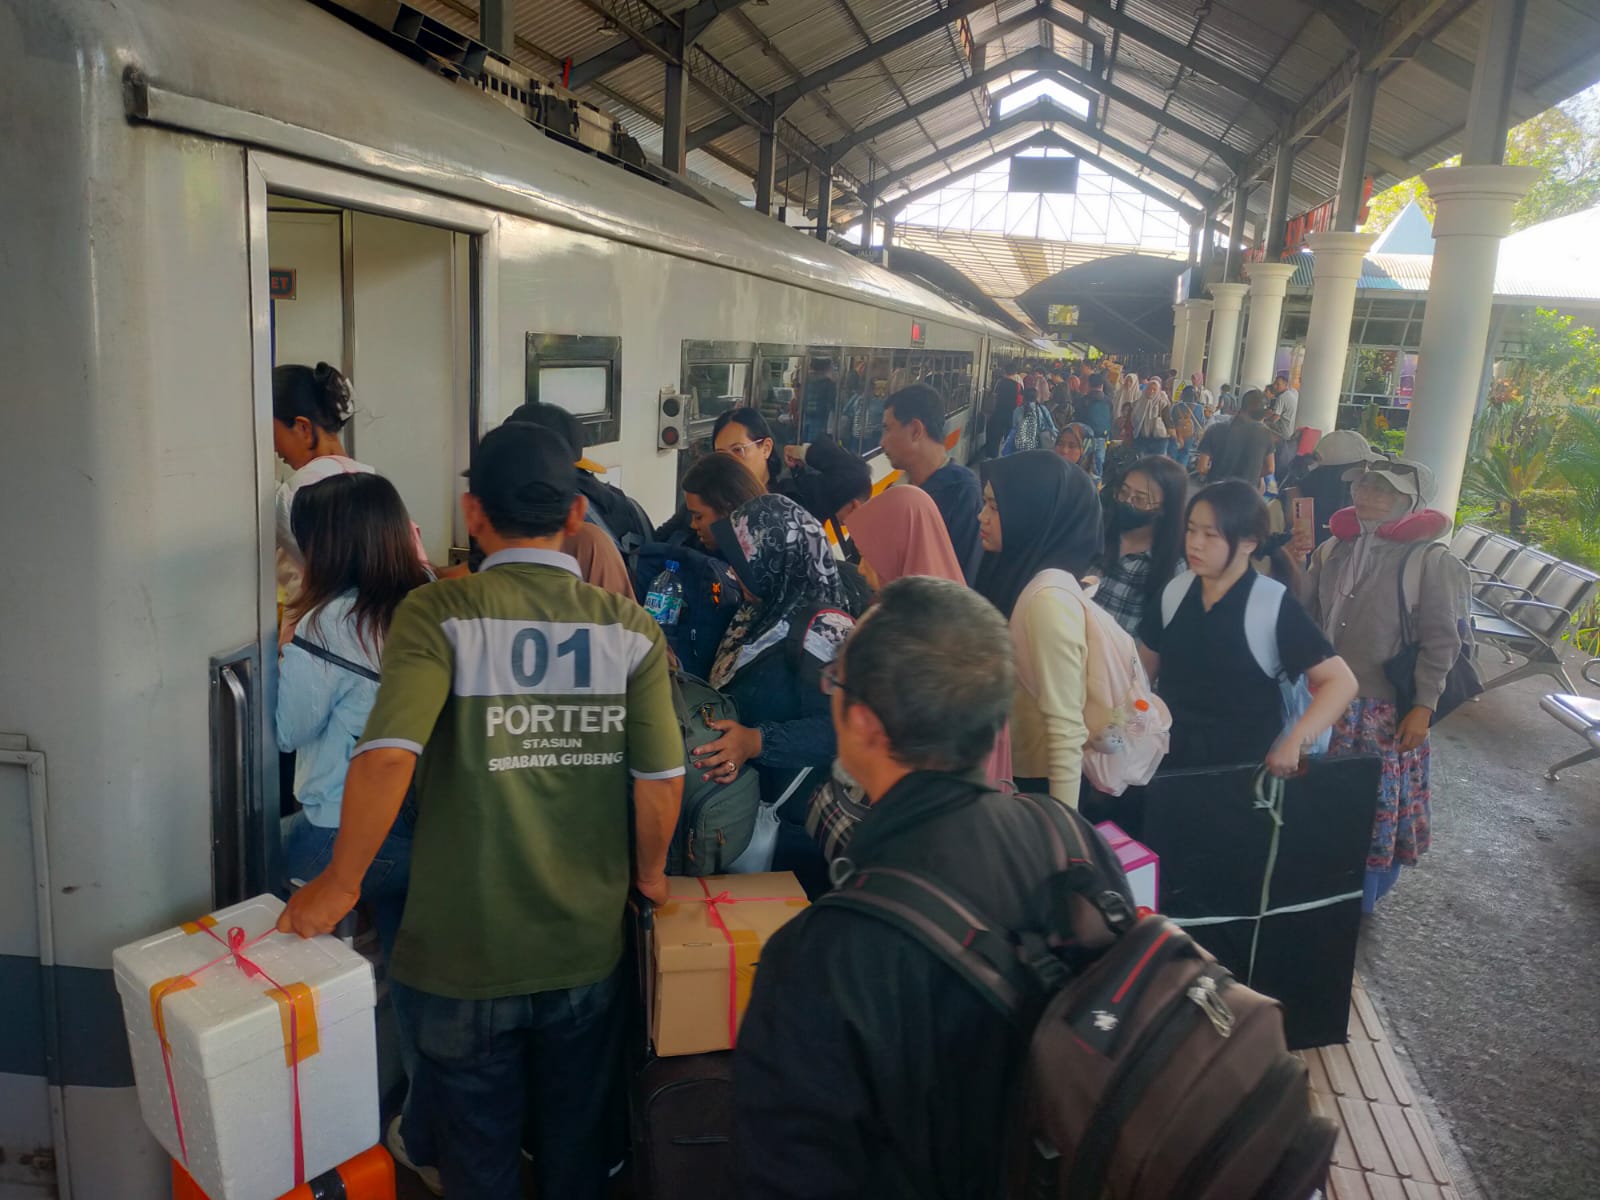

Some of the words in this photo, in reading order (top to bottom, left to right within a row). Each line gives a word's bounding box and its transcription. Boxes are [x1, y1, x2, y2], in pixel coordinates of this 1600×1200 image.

[511, 627, 592, 688] 01
[486, 704, 627, 737] PORTER
[522, 738, 583, 749] STASIUN
[488, 753, 558, 771] SURABAYA
[560, 751, 624, 766] GUBENG
